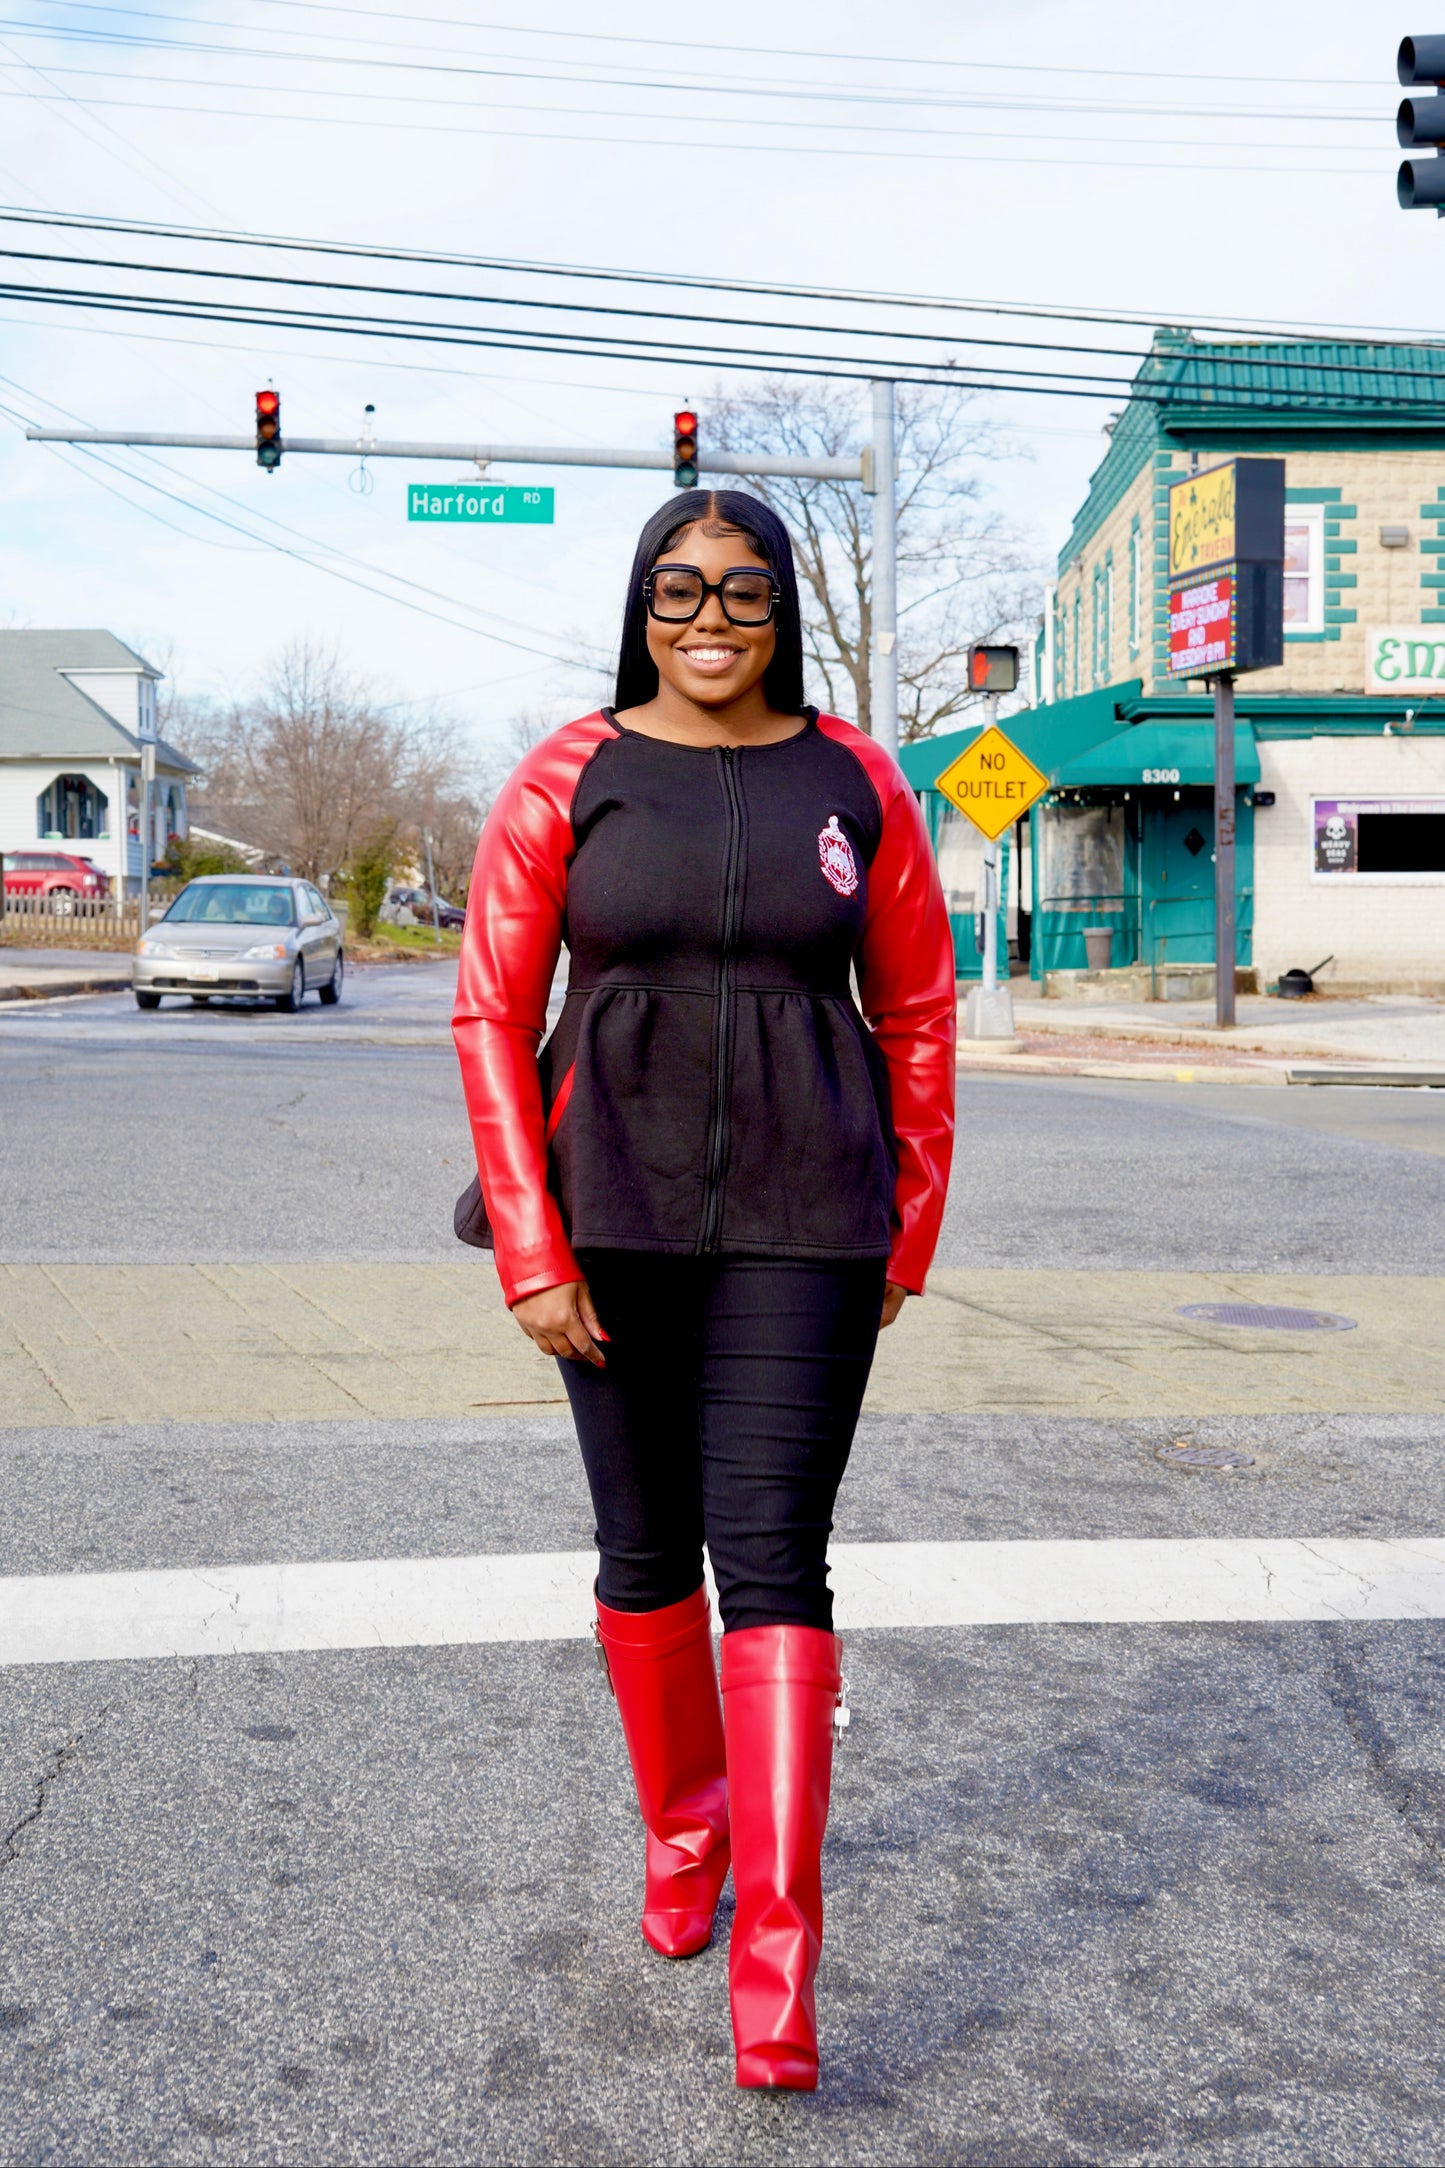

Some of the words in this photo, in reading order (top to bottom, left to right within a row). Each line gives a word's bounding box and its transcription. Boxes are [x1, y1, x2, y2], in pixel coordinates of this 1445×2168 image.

[412, 492, 505, 516] Harford
[523, 492, 541, 505] RD
[1173, 467, 1236, 570] Emerald
[1201, 535, 1235, 561] TAVERN
[1171, 607, 1197, 633] EVERY
[1196, 599, 1230, 626] SUNDAY
[980, 753, 1006, 771] NO
[1142, 768, 1180, 784] 8300
[956, 781, 1027, 799] OUTLET
[1321, 840, 1351, 850] HEAVY
